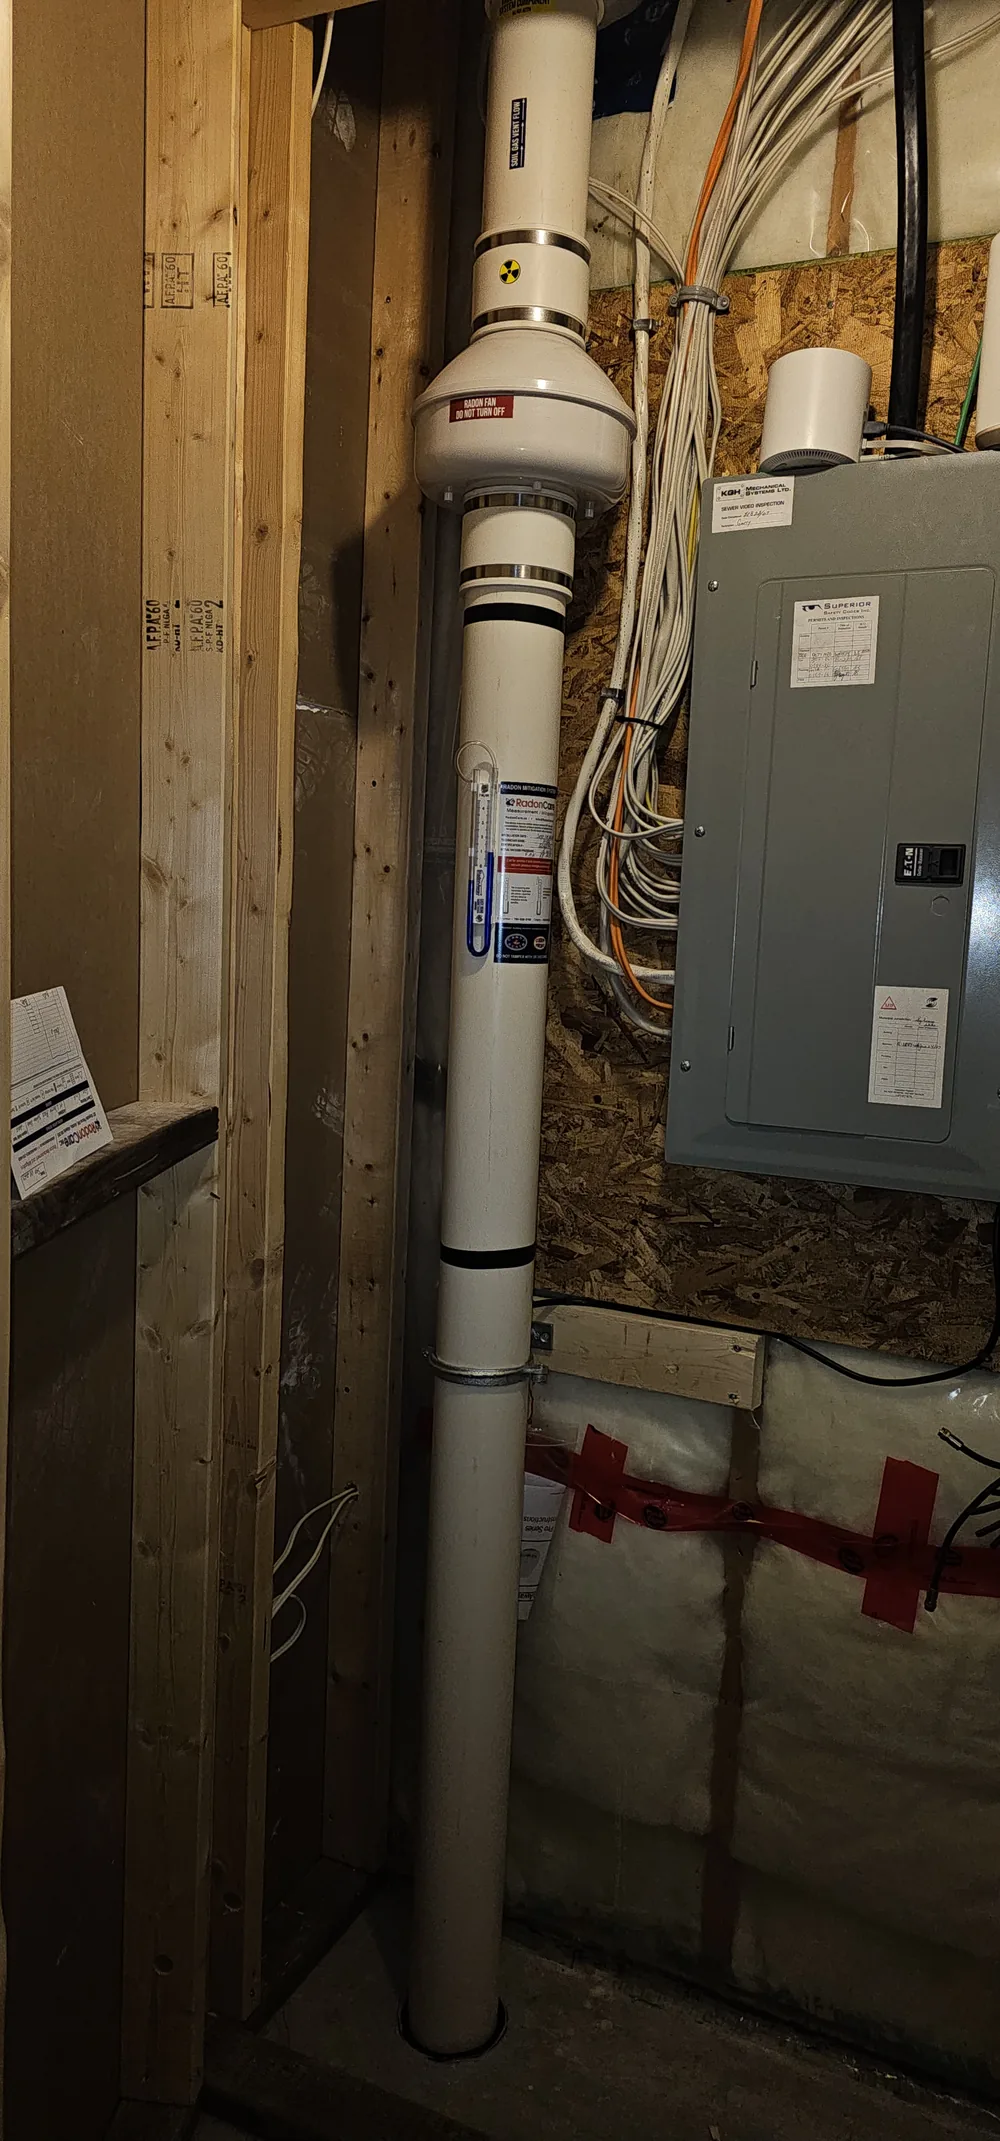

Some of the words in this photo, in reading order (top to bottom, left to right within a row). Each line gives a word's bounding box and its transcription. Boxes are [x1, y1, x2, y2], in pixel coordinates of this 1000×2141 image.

[513, 101, 521, 120] FLOW
[512, 120, 520, 138] VENT
[511, 151, 519, 168] SOIL
[463, 398, 484, 409] RADON
[484, 397, 497, 407] FAN
[455, 410, 464, 420] DO
[464, 408, 475, 418] NOT
[477, 407, 492, 417] TURN
[493, 406, 506, 416] OFF
[755, 500, 785, 508] INSPECTION
[204, 600, 223, 609] 2
[205, 609, 213, 630] NLGA
